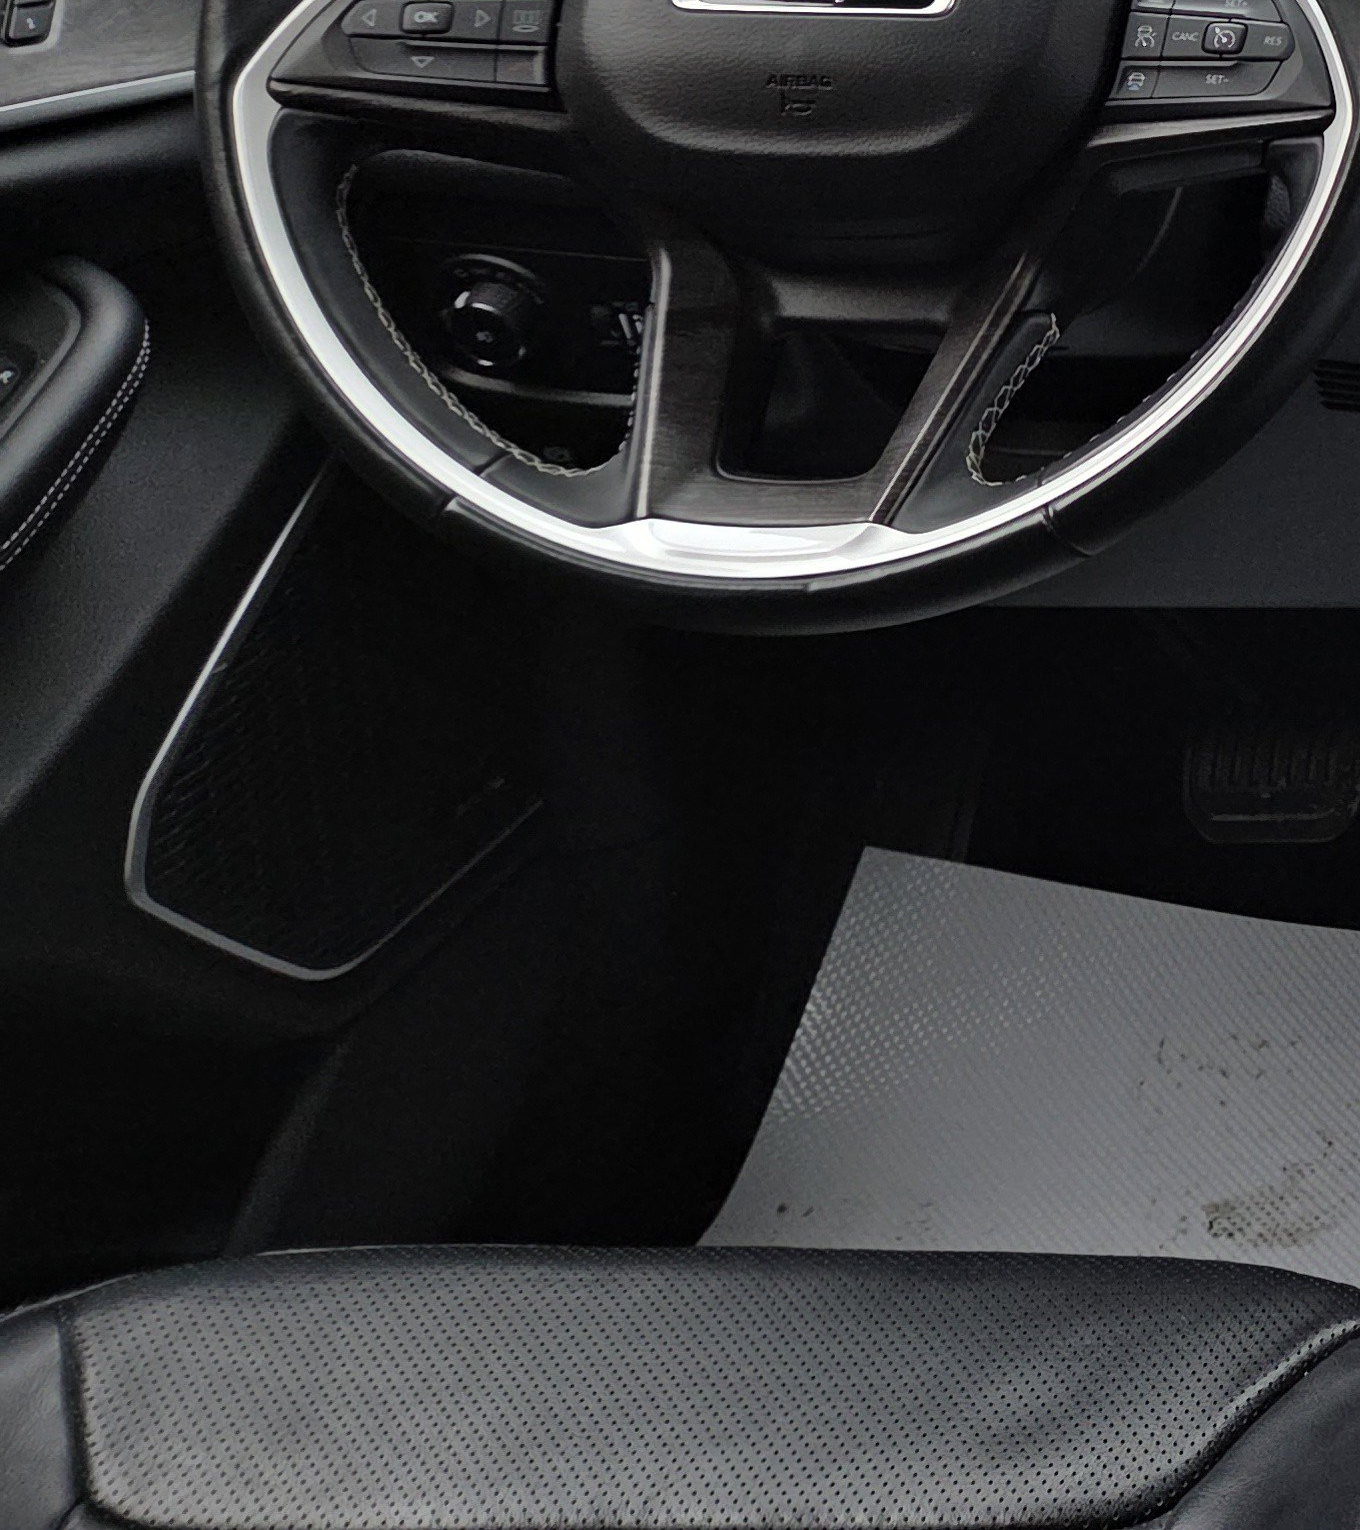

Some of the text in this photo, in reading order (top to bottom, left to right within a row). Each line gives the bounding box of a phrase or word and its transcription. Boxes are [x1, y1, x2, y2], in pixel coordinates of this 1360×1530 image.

[414, 11, 438, 23] OK
[1171, 31, 1199, 42] CANC
[1263, 35, 1282, 46] RES
[764, 73, 833, 90] AIRBAG
